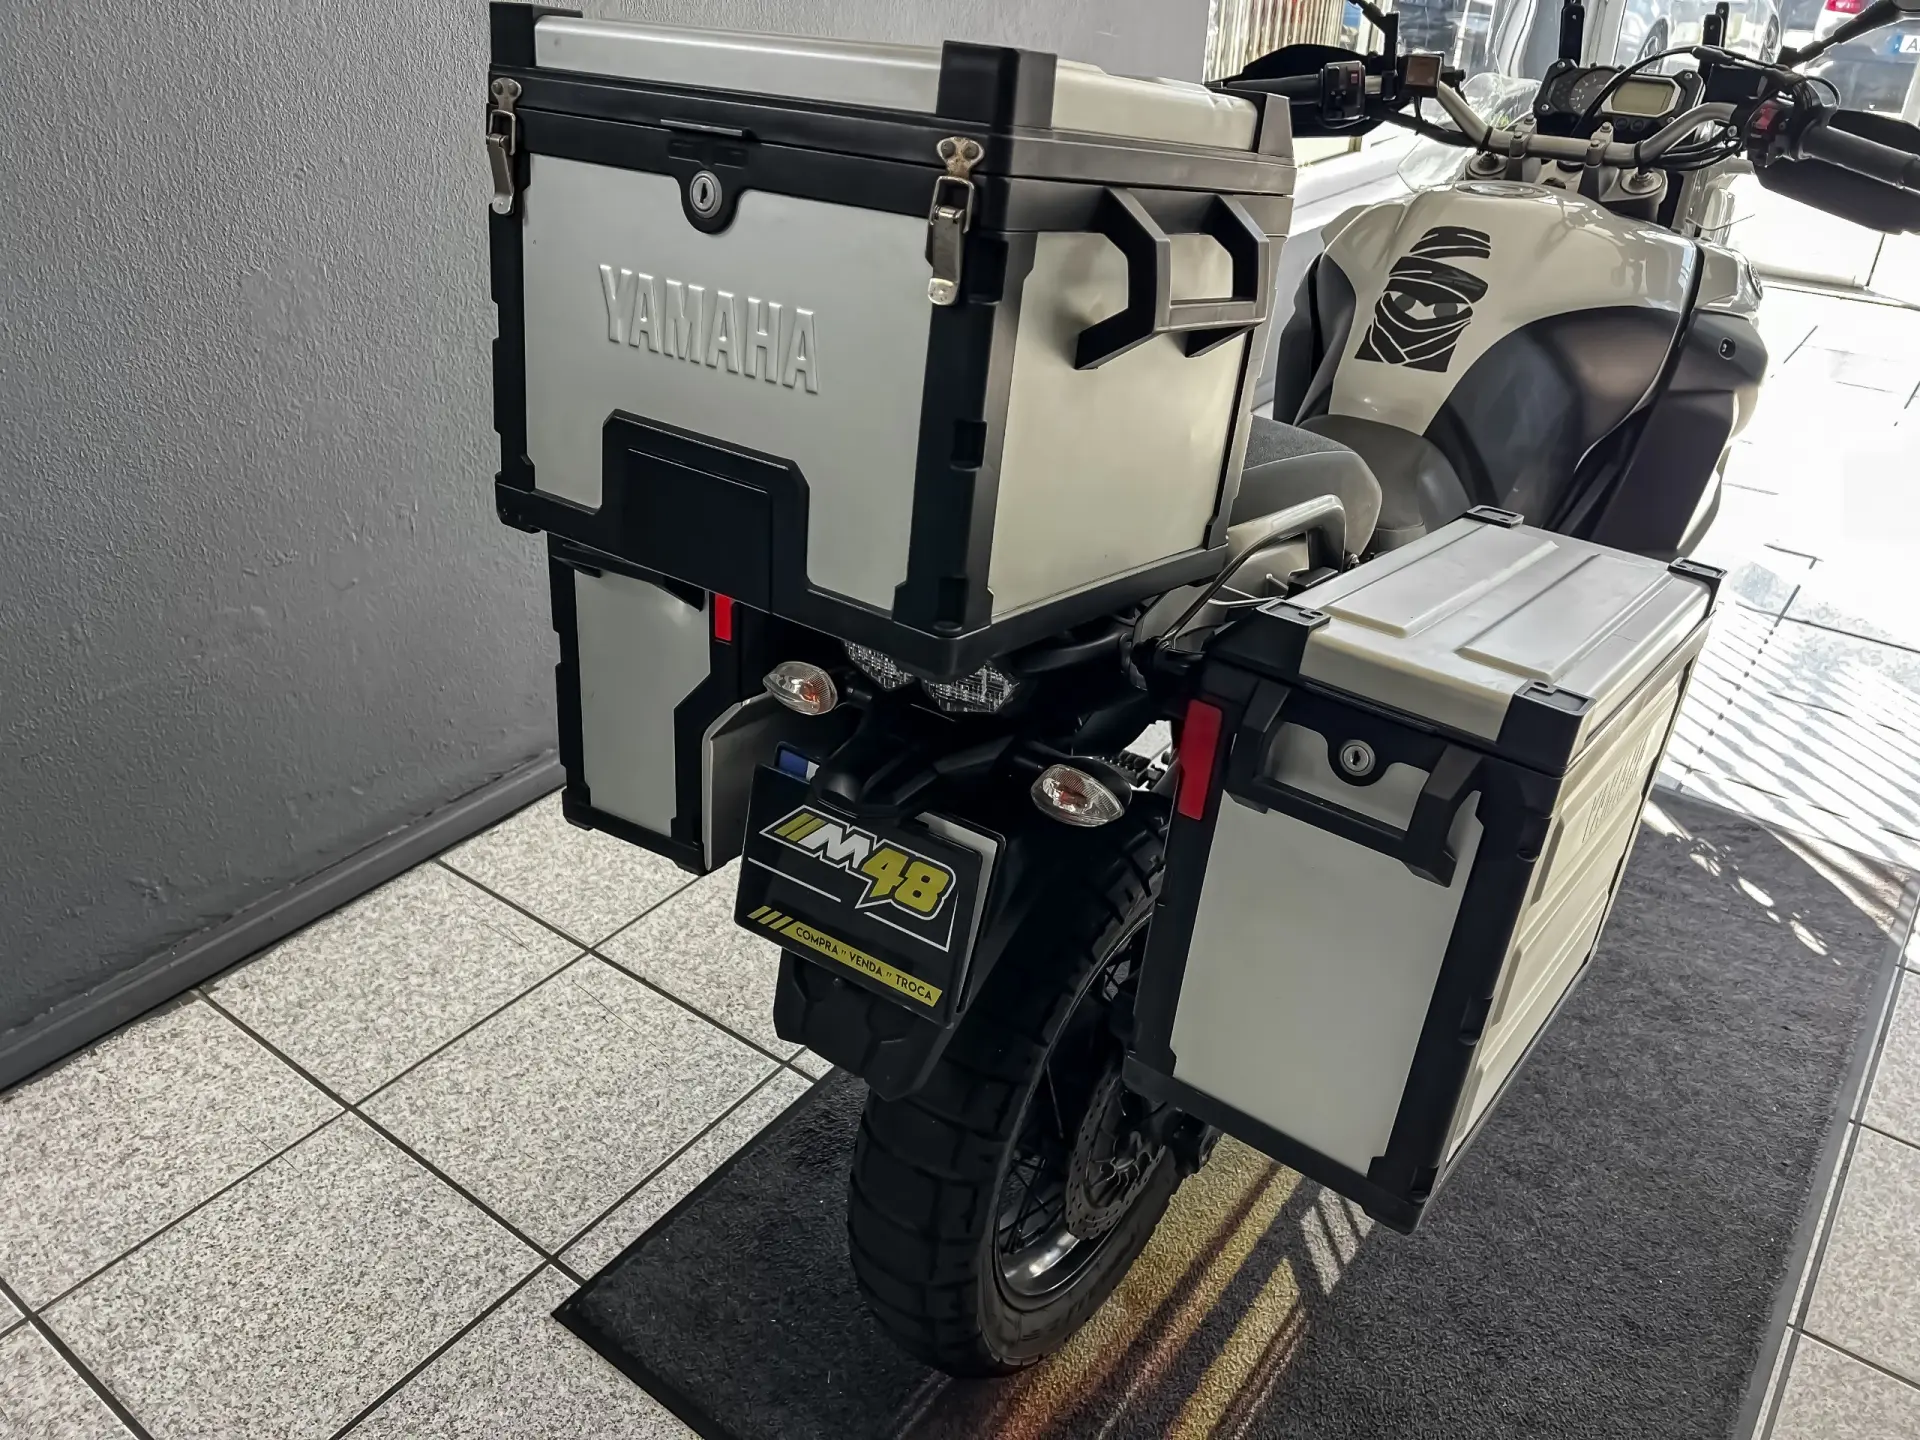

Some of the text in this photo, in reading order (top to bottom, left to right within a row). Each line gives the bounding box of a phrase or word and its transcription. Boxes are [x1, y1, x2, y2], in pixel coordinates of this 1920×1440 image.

[599, 264, 819, 395] YAMAHA
[795, 926, 932, 1001] COMPRA VENDA TROCA
